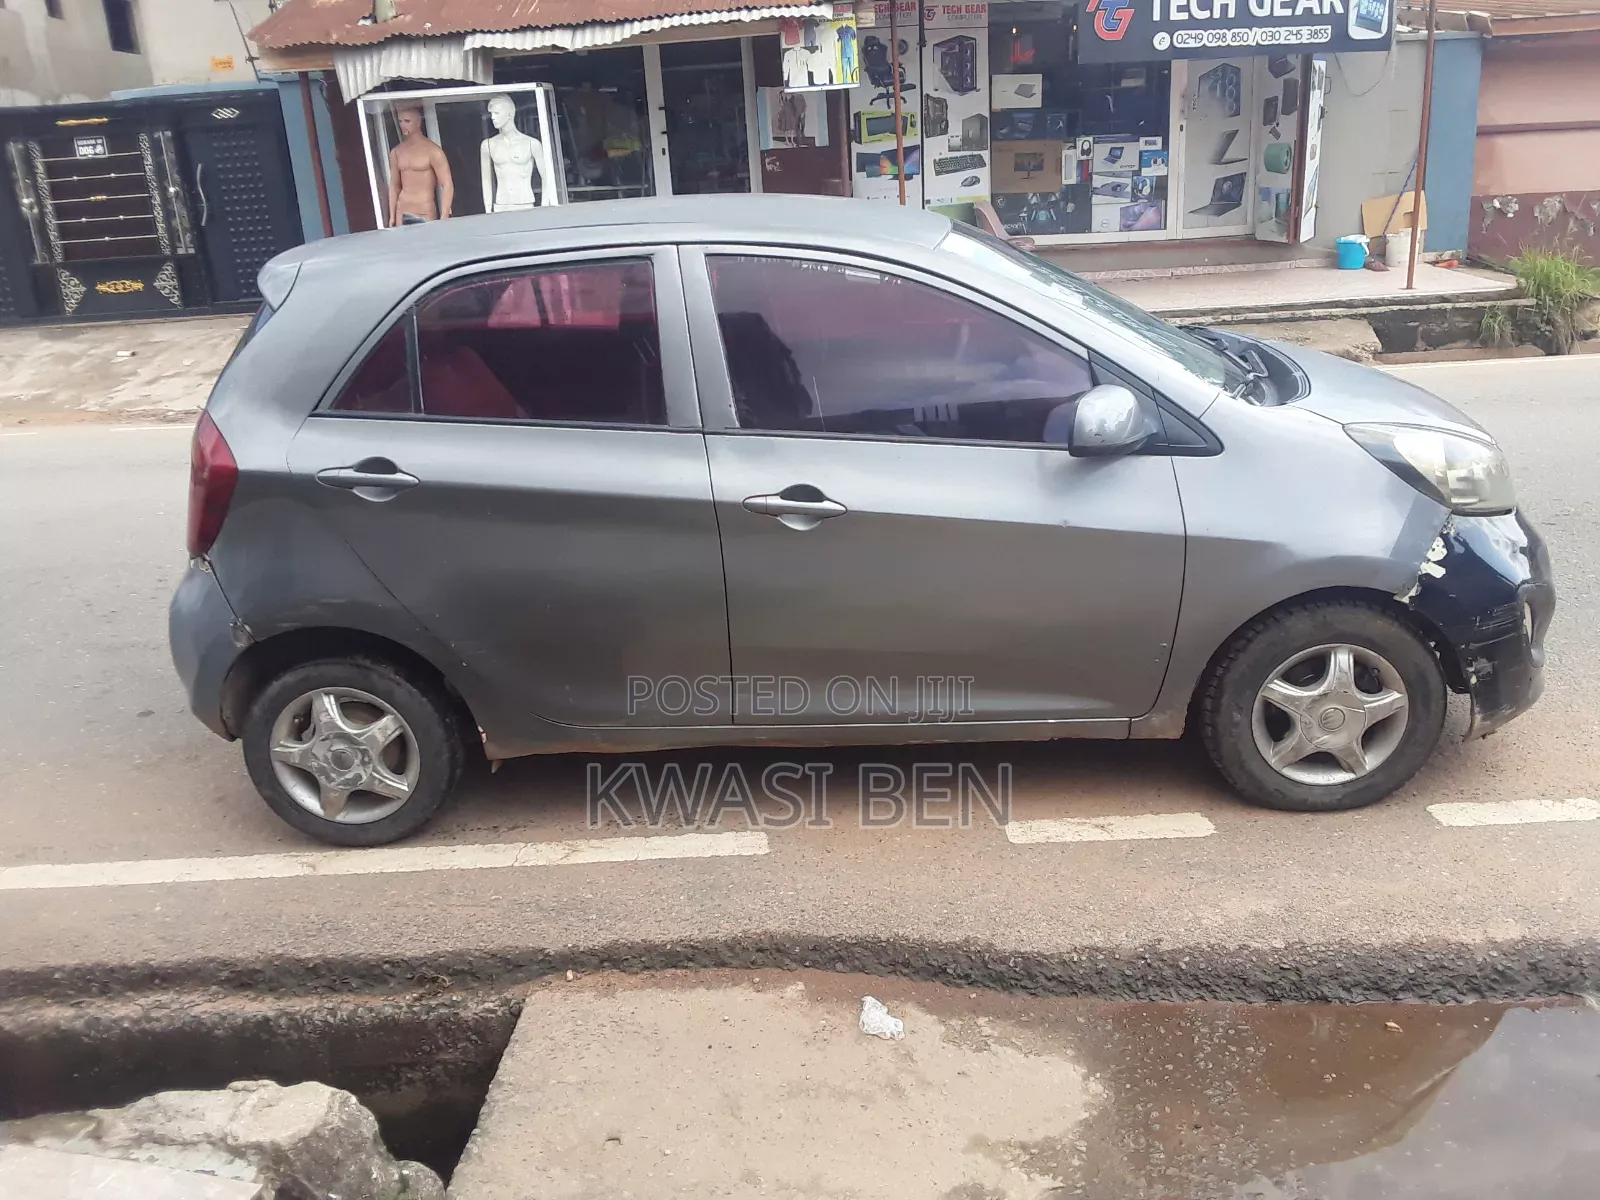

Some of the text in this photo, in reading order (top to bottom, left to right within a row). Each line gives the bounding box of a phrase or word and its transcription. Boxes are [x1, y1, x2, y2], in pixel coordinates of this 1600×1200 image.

[942, 4, 987, 15] TECH GEAR
[1175, 33, 1204, 45] 0249
[1207, 32, 1228, 43] 098
[1231, 32, 1250, 43] 850
[1260, 30, 1282, 42] 030
[1284, 30, 1303, 41] 245
[1306, 28, 1330, 40] 3855
